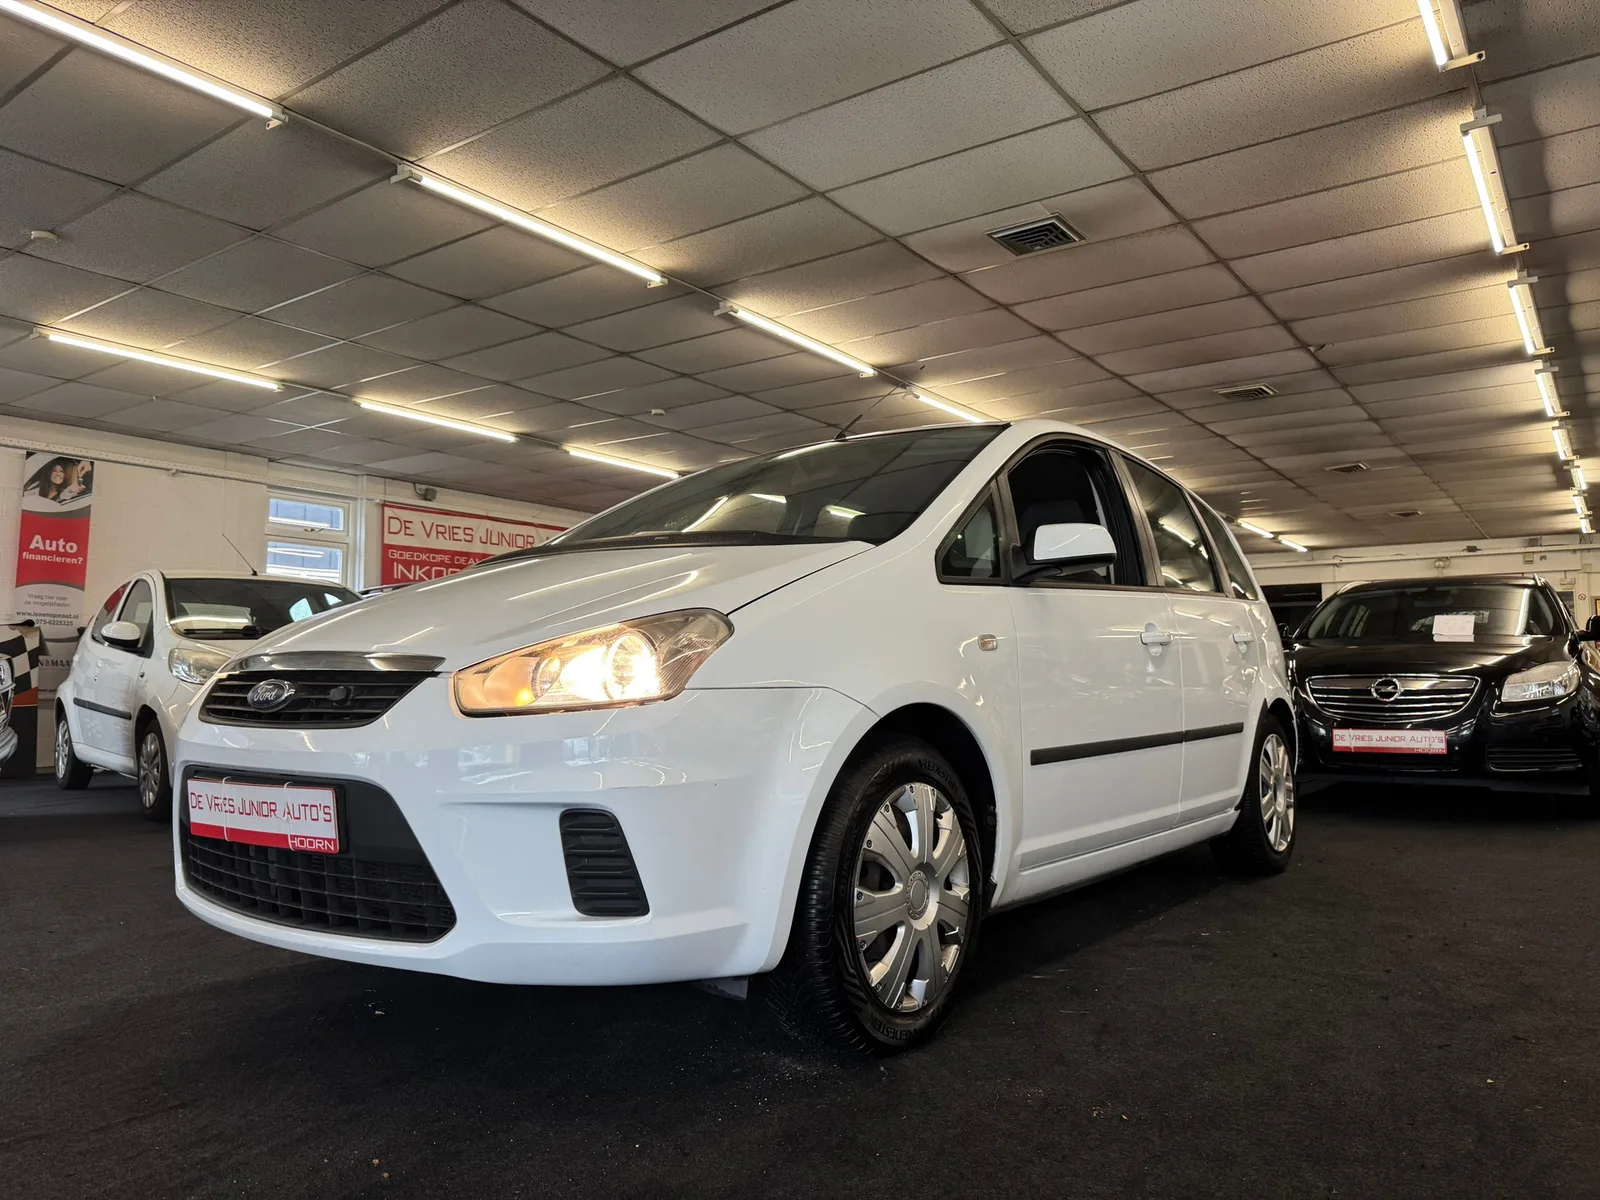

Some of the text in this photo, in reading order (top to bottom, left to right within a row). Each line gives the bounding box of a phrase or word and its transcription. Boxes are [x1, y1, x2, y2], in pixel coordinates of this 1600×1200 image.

[387, 515, 535, 549] DE VRIES JUNIOR
[29, 534, 78, 554] Auto
[22, 551, 84, 565] financieren?
[388, 549, 452, 564] GOEDKOPE
[254, 684, 278, 701] Ford
[1334, 734, 1444, 744] DE VRIES JUNIOR AUTO'S
[190, 792, 332, 823] DE VRIES JUNIOR AUTO'S
[290, 837, 334, 851] HOORN
